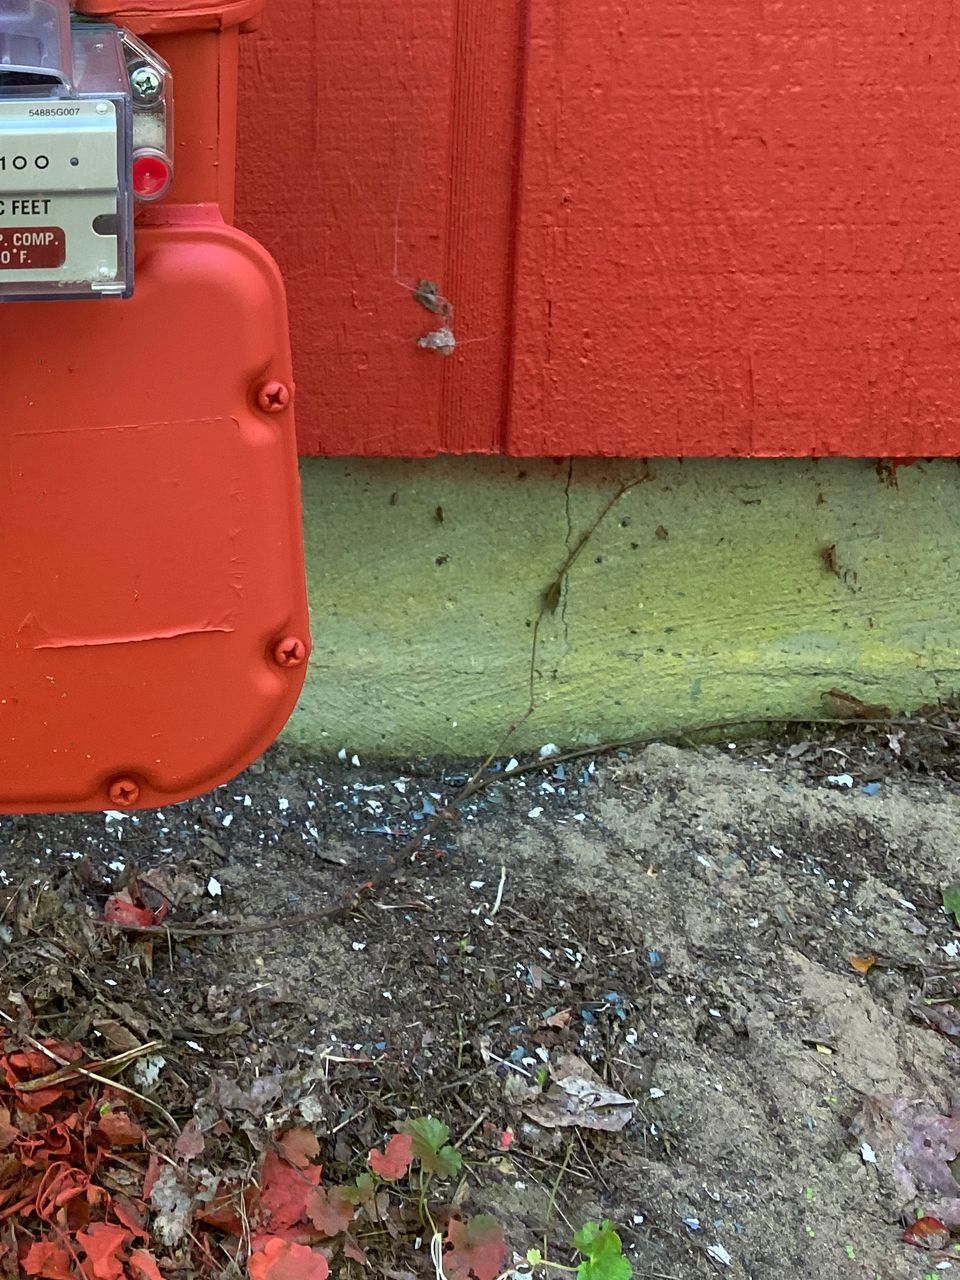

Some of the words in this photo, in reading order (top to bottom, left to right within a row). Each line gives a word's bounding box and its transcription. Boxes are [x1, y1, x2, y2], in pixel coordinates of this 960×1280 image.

[28, 107, 80, 117] 54885G007
[11, 199, 52, 215] FEET
[13, 232, 59, 247] COMP.
